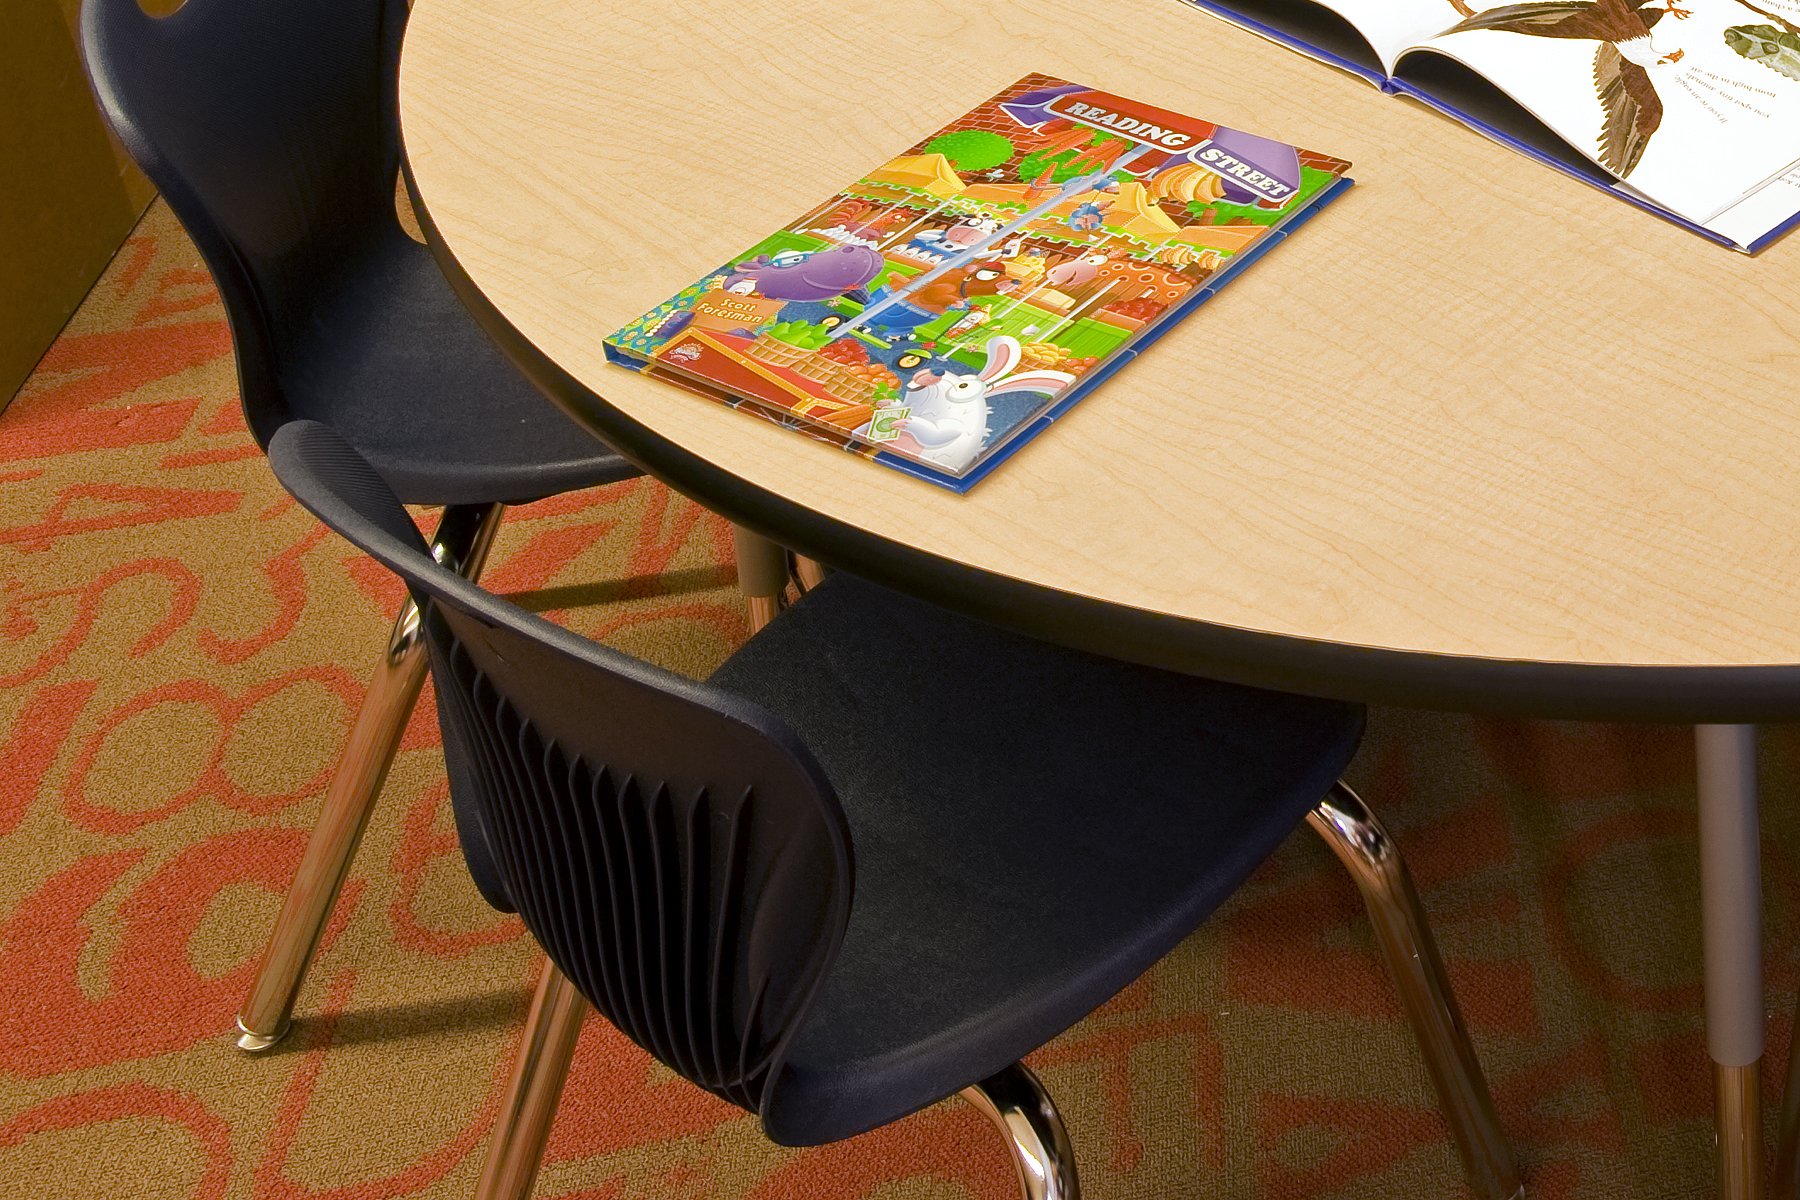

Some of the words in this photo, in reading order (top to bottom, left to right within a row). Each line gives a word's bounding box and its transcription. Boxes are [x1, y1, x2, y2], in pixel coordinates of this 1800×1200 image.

[1685, 72, 1717, 92] animals
[1707, 73, 1719, 82] the
[1732, 80, 1752, 92] high
[1064, 102, 1192, 147] READING
[1200, 148, 1291, 197] STREET
[697, 302, 763, 323] Foresman
[720, 298, 757, 313] Scott
